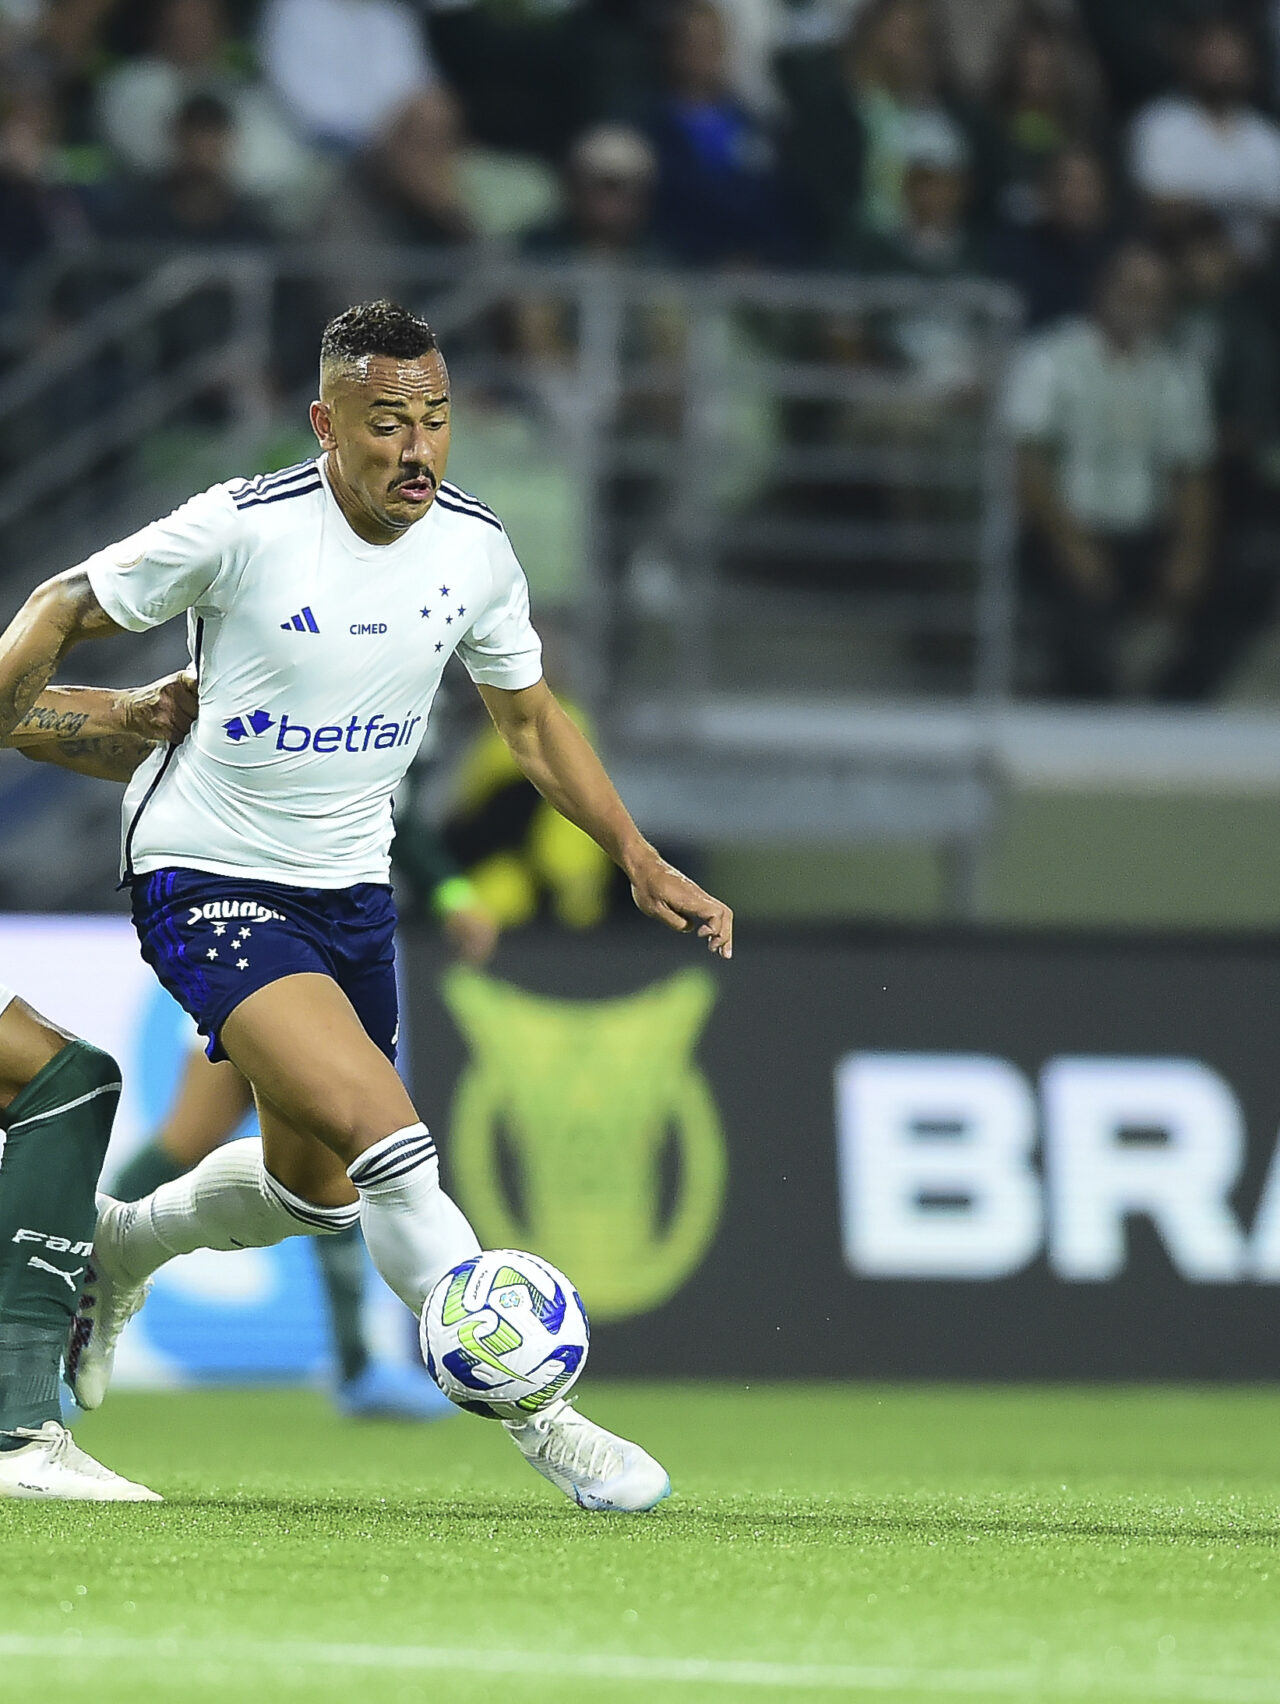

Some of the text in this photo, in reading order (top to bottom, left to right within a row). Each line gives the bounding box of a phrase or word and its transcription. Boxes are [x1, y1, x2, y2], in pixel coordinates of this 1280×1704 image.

[350, 623, 388, 635] CIMED
[276, 710, 422, 753] betfair
[833, 1051, 1280, 1284] BR
